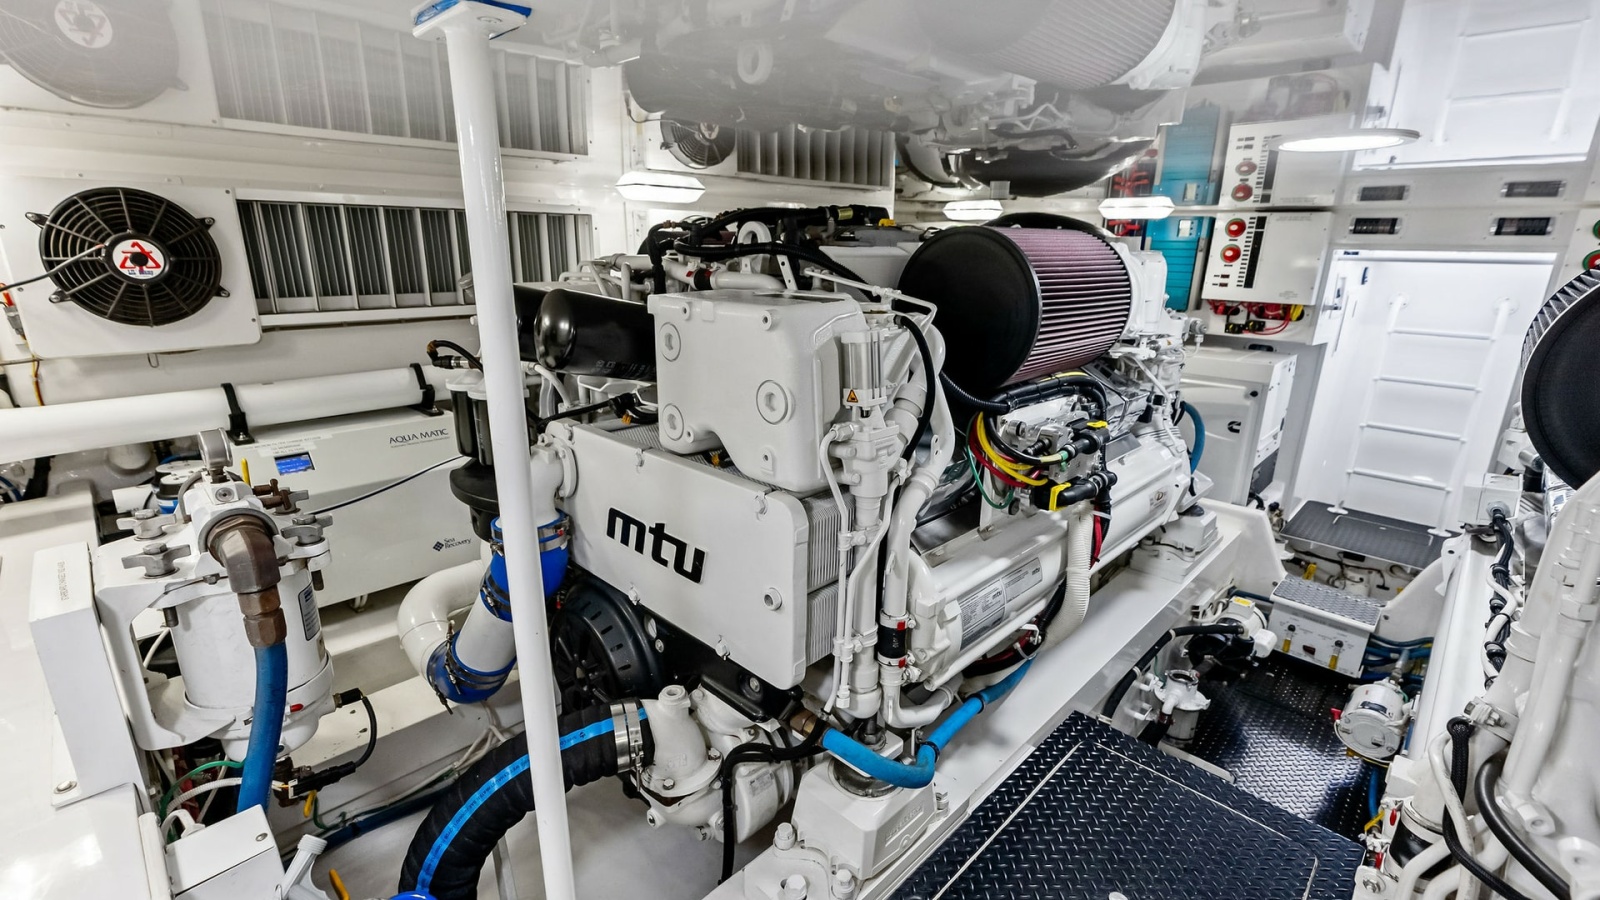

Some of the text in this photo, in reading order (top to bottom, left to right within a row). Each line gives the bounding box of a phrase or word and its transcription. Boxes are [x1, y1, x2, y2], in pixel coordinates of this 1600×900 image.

[389, 433, 419, 444] AQUA
[420, 428, 449, 439] MATIC
[445, 538, 471, 549] Recovery
[606, 507, 706, 584] mtu
